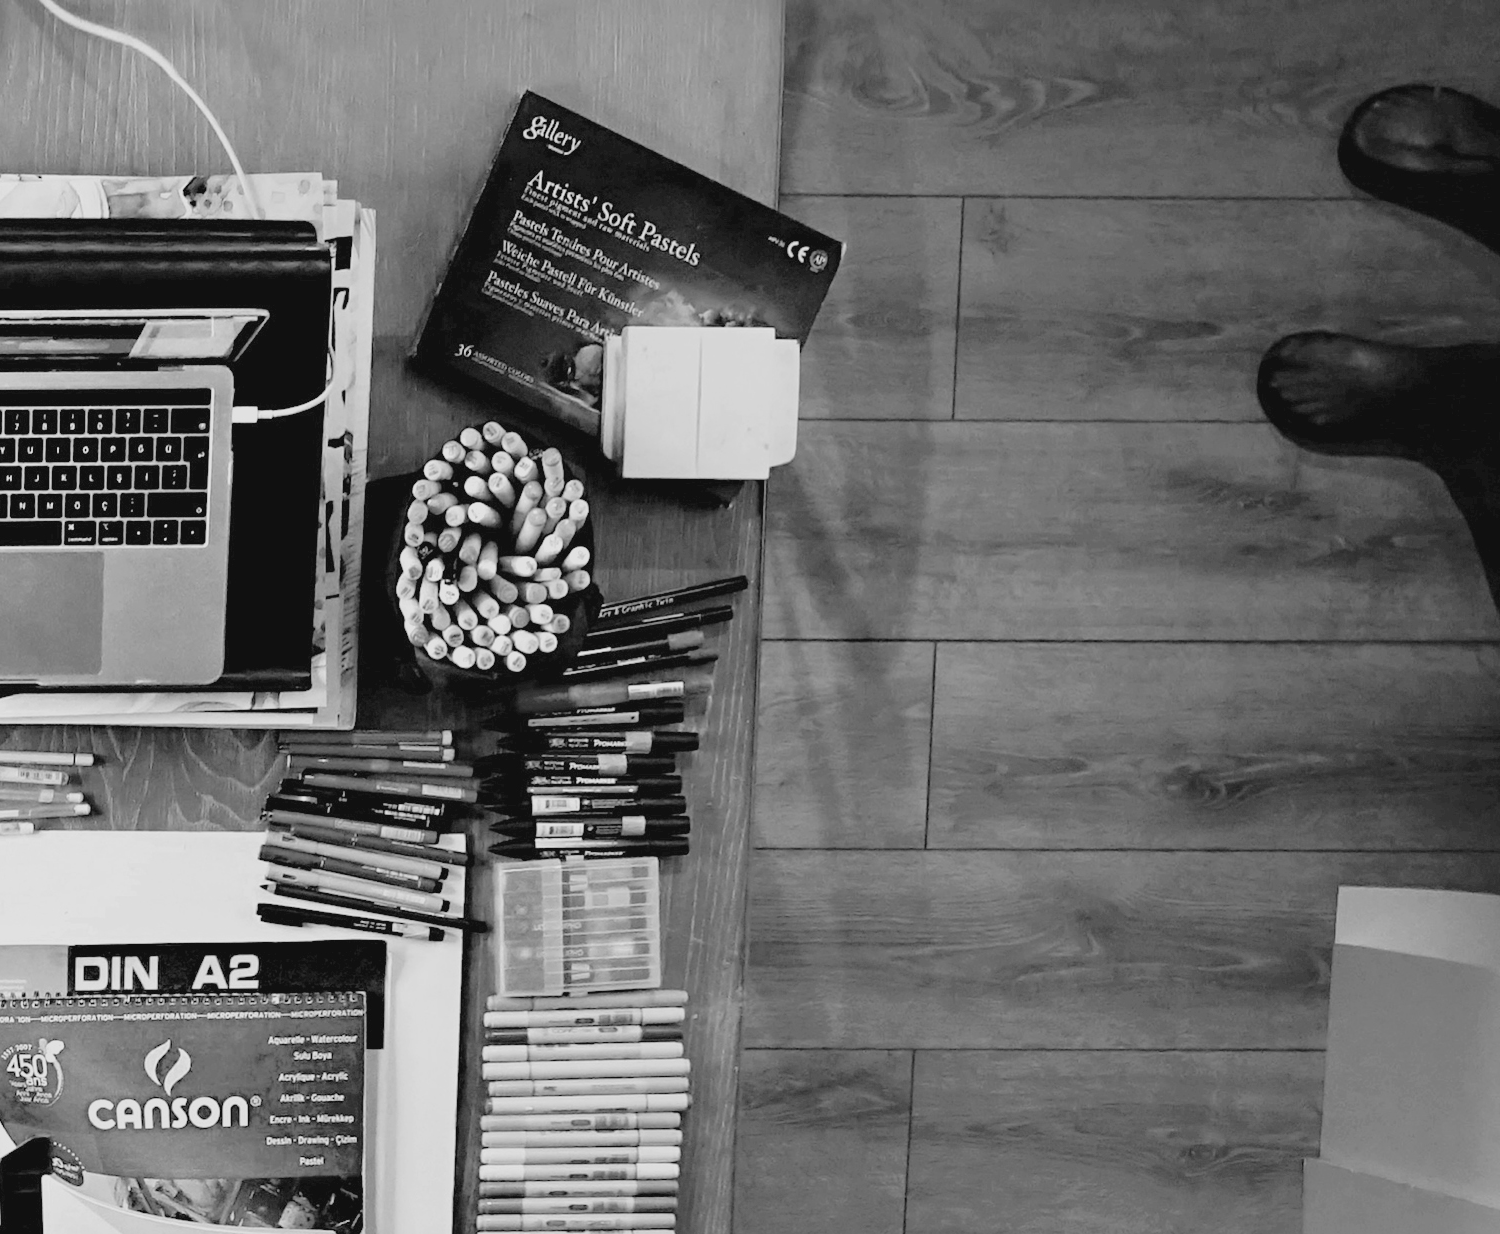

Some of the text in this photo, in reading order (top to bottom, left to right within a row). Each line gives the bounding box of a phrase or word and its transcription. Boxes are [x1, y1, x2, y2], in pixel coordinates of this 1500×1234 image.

[523, 115, 581, 155] gallery
[526, 167, 705, 267] Artists' Soft Pastels
[511, 209, 662, 290] Pastels Tendres Pour Artistes
[498, 239, 646, 318] Weiche Pastell Für Künstler
[485, 269, 531, 300] Pasteles
[529, 290, 567, 316] Suaves
[565, 308, 592, 329] Para
[453, 339, 474, 361] 36
[75, 954, 260, 991] DIN A2
[268, 1035, 358, 1045] Aquarelle Watercolour
[6, 1054, 47, 1077] 450
[293, 1051, 332, 1061] Sulu Boya
[26, 1077, 47, 1086] ans
[278, 1072, 348, 1082] Acrylique Acrylic
[311, 1093, 344, 1102] Gouache
[88, 1096, 249, 1130] CANSON
[270, 1115, 292, 1124] Encre
[298, 1115, 310, 1123] Ink
[266, 1136, 292, 1145] Dessin
[298, 1136, 329, 1146] Drawing
[300, 1156, 324, 1166] Pastel
